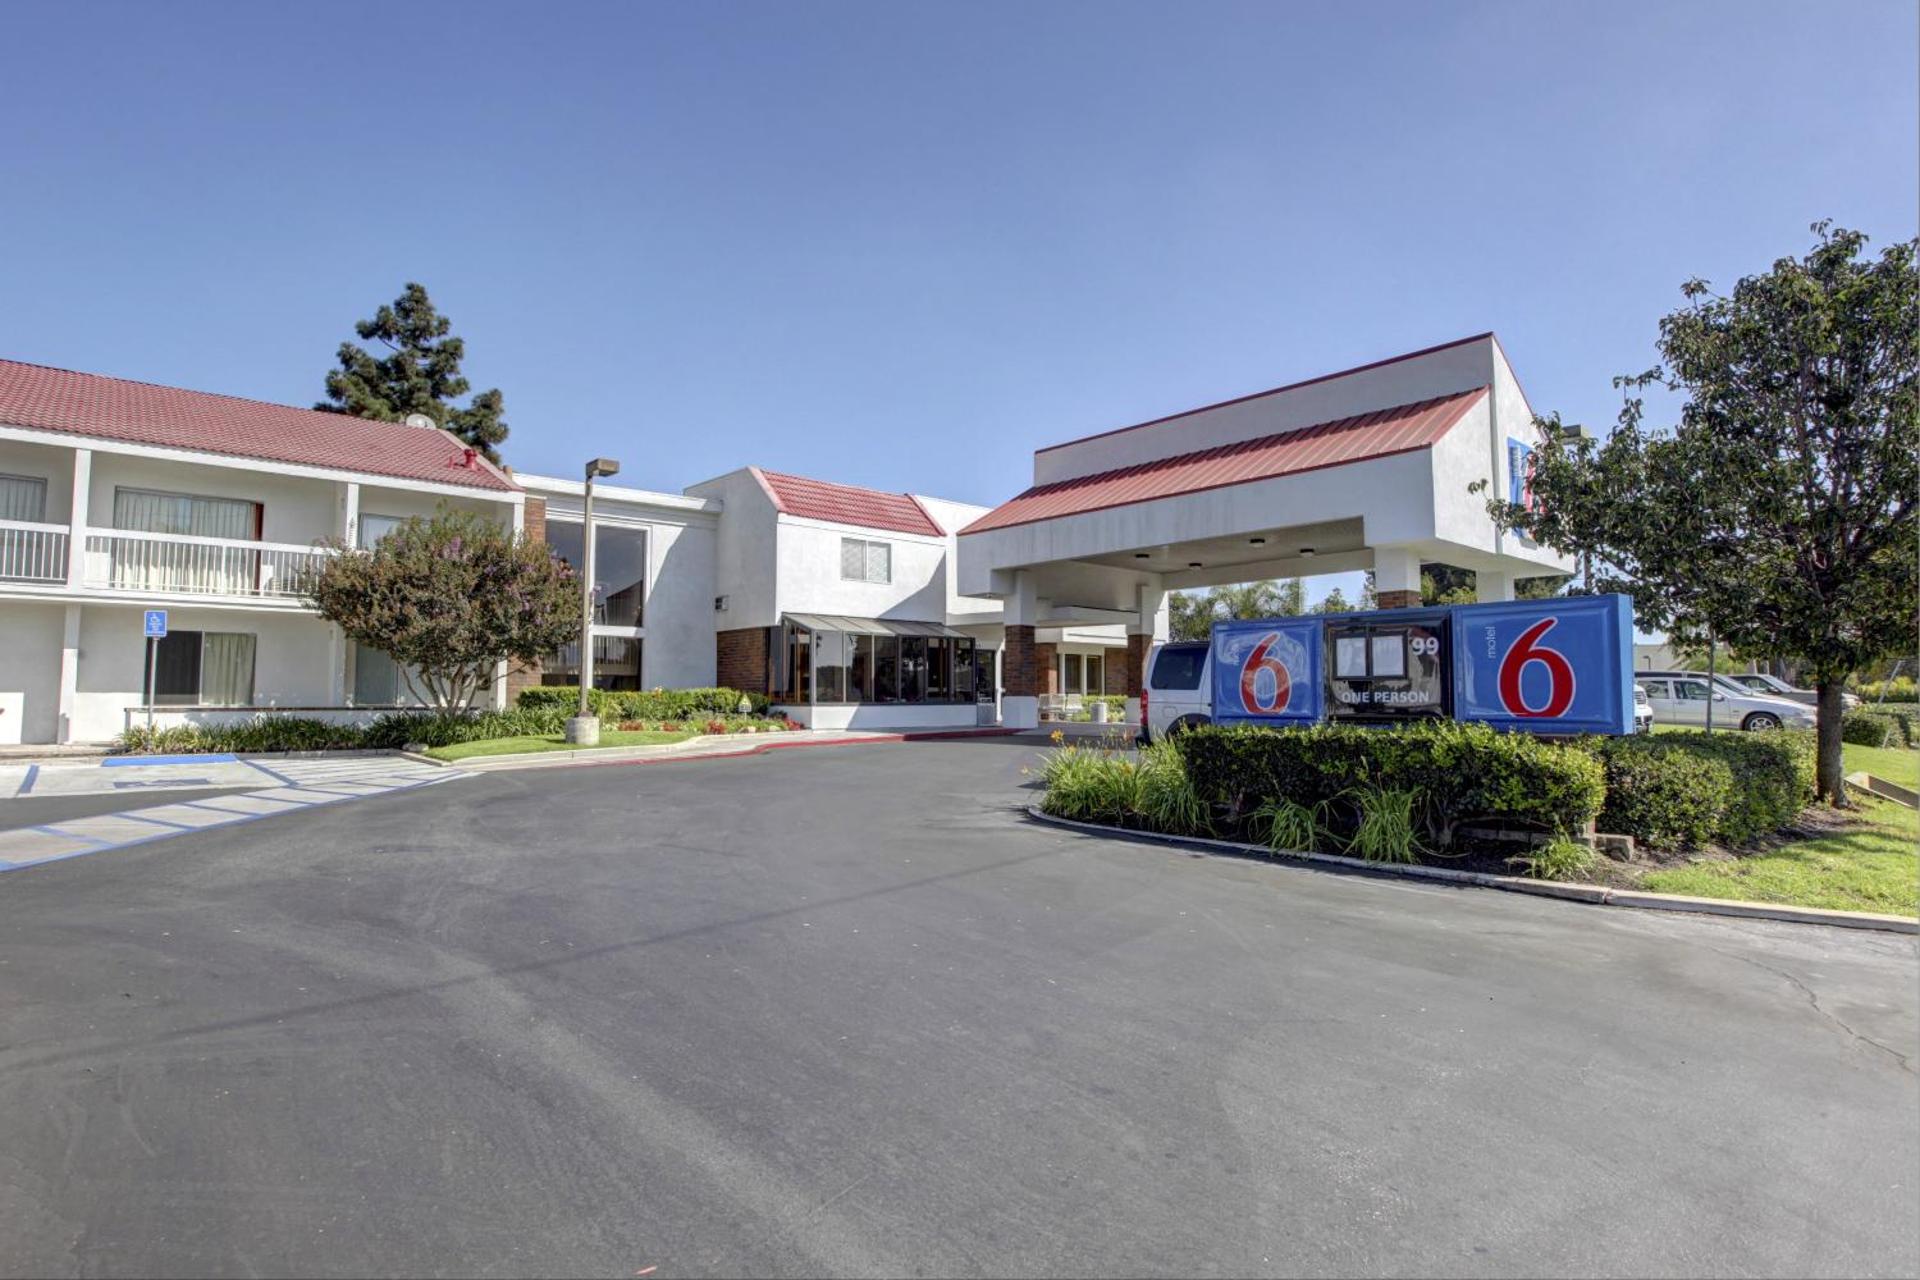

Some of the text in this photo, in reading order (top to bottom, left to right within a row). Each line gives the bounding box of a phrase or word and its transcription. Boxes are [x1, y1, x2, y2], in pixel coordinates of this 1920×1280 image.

[1411, 637, 1439, 655] 99
[1485, 616, 1576, 718] motel 6
[1239, 631, 1292, 714] 6
[1341, 691, 1429, 703] ONE PERSON
